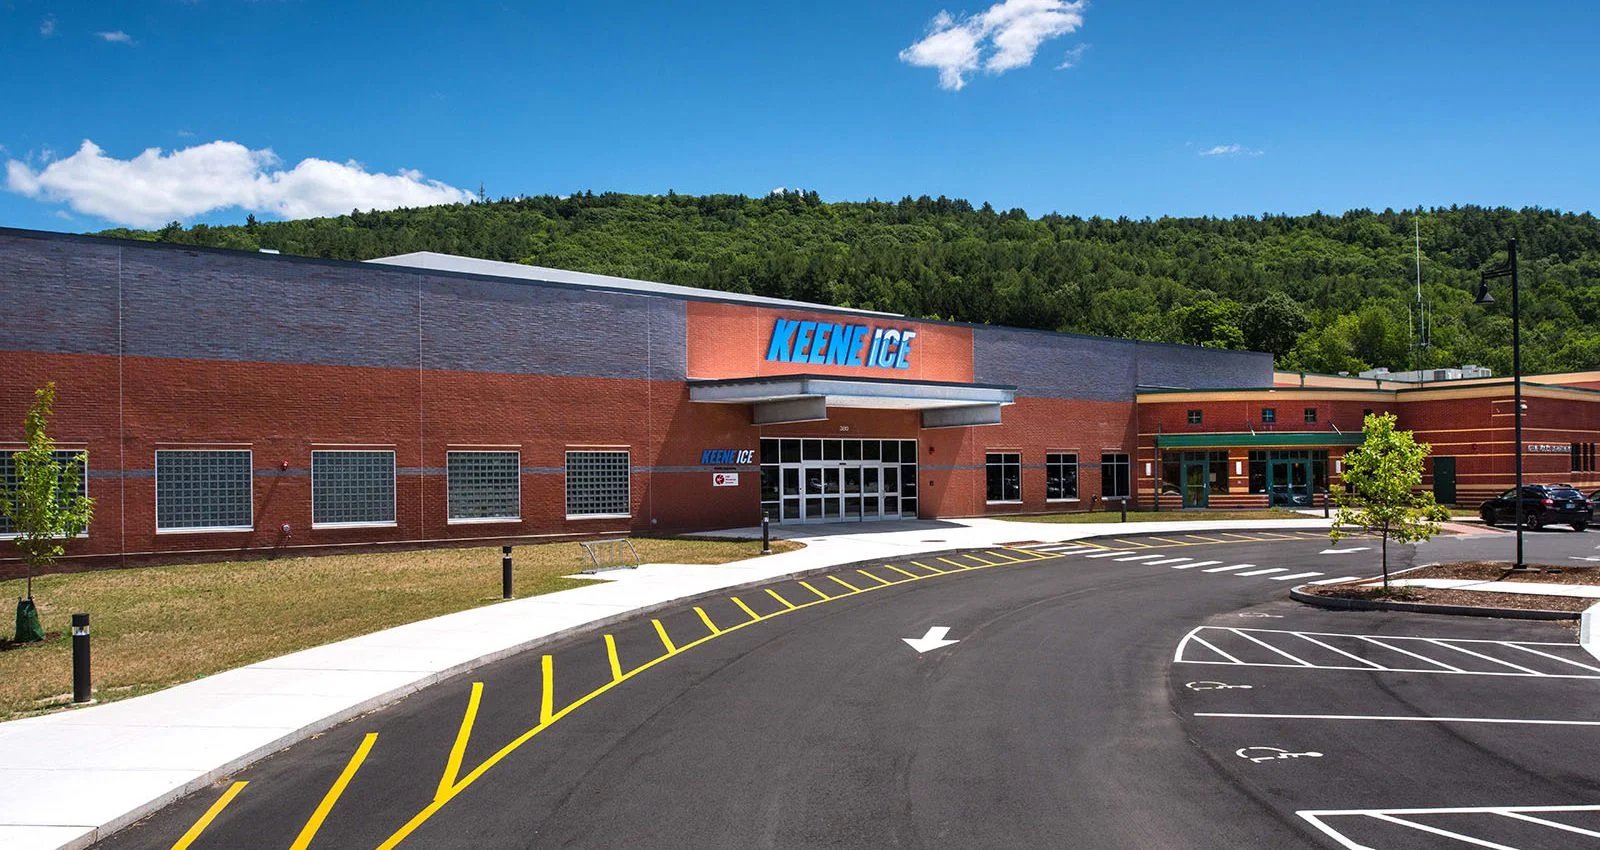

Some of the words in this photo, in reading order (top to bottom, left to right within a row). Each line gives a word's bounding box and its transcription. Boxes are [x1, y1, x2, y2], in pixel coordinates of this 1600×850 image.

[766, 318, 870, 367] KEENE
[866, 328, 917, 369] ICE
[701, 450, 737, 464] KEENE
[736, 450, 755, 464] ICE
